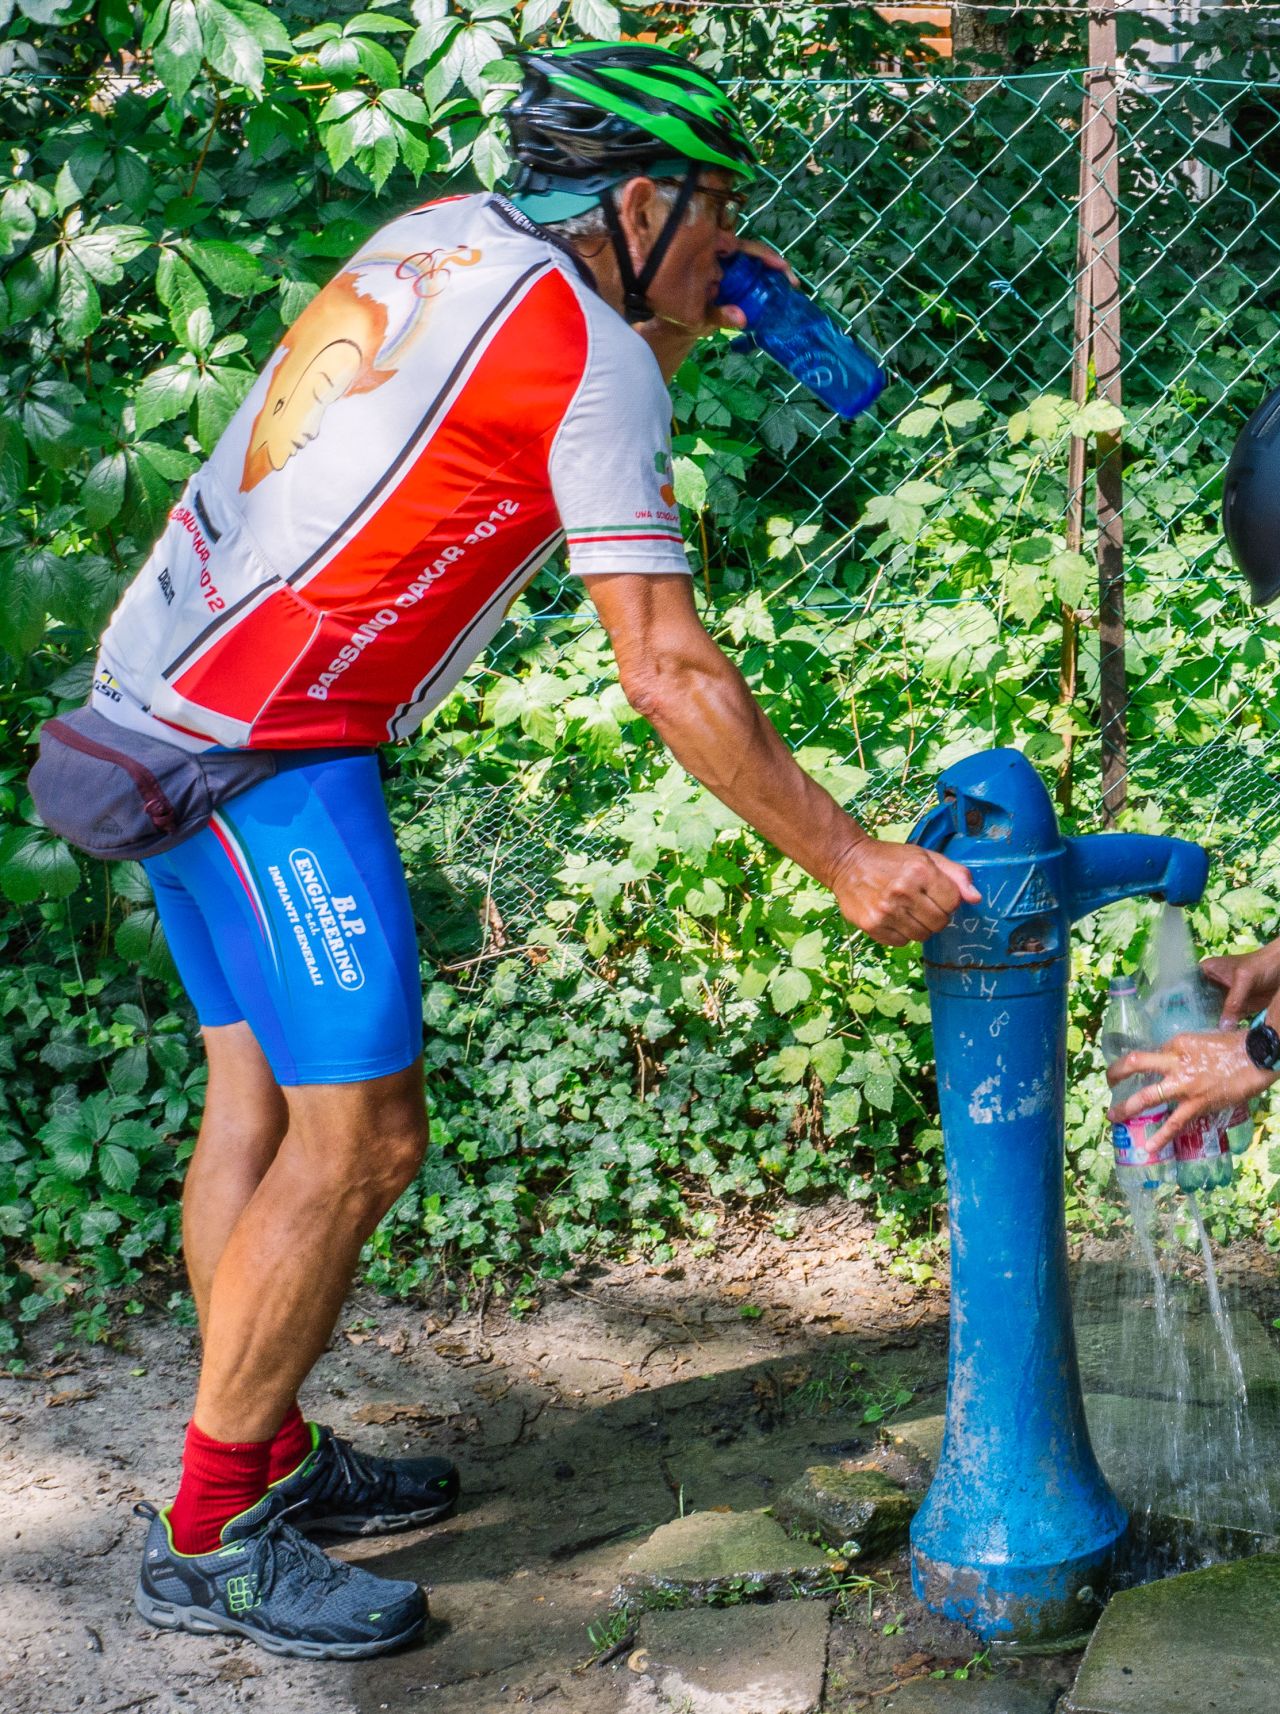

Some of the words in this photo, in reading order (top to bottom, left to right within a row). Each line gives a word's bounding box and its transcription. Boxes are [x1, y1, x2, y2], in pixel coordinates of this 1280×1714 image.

[307, 608, 398, 700] BASSANO
[395, 545, 466, 608] DAKAR
[464, 498, 521, 546] 2012
[268, 865, 301, 924] IMPIANTI
[293, 924, 325, 987] GENERALI
[295, 857, 358, 984] ENGINEERING
[330, 895, 367, 938] B.P.
